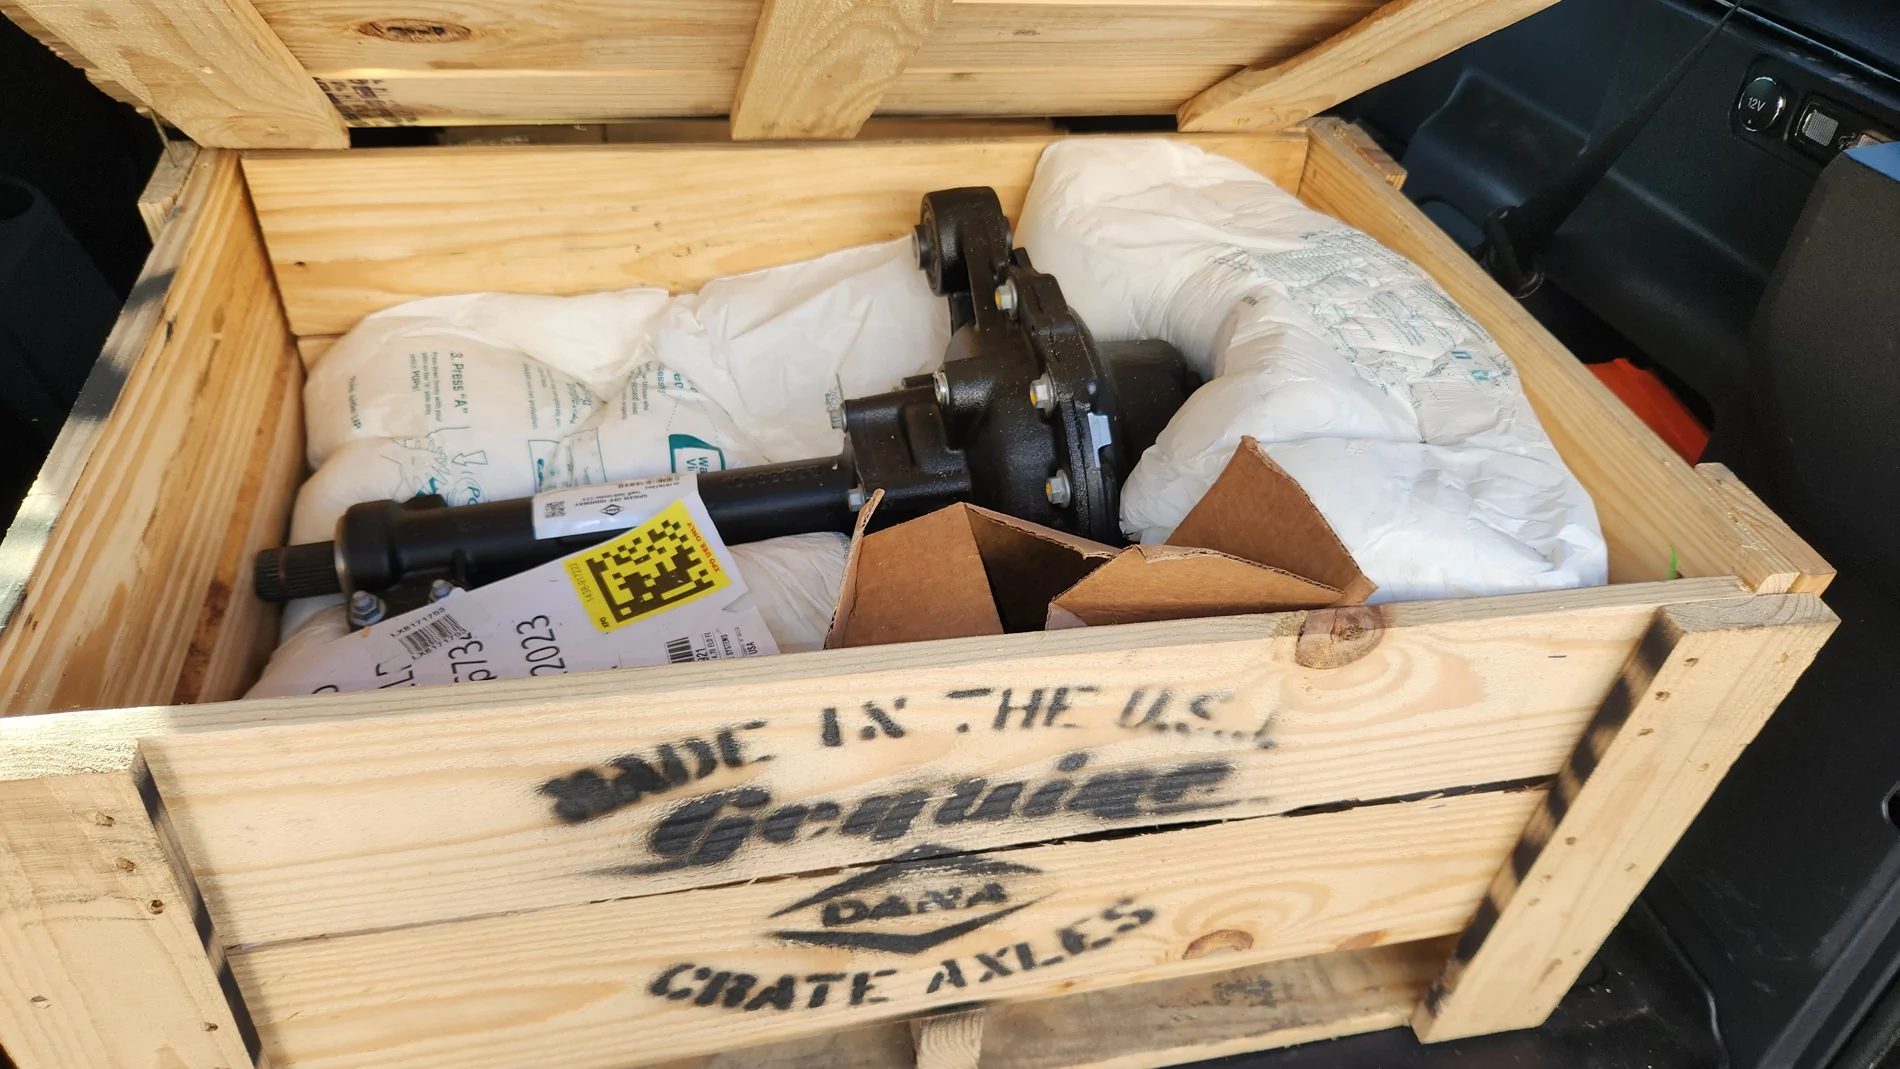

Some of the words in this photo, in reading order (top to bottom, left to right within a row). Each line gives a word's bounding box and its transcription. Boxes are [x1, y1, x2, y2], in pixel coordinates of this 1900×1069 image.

[1747, 97, 1766, 112] 12V
[450, 362, 466, 391] Press
[574, 499, 607, 508] HIGHWAY
[686, 521, 701, 542] ONLY
[710, 558, 721, 573] XPO
[720, 633, 734, 657] SYSTEMS
[745, 641, 758, 656] USA
[945, 684, 1101, 734] THE
[648, 750, 1240, 868] Genuine
[820, 881, 1009, 928] DANA
[648, 961, 899, 1012] CRATE
[924, 898, 1157, 995] AXLES
